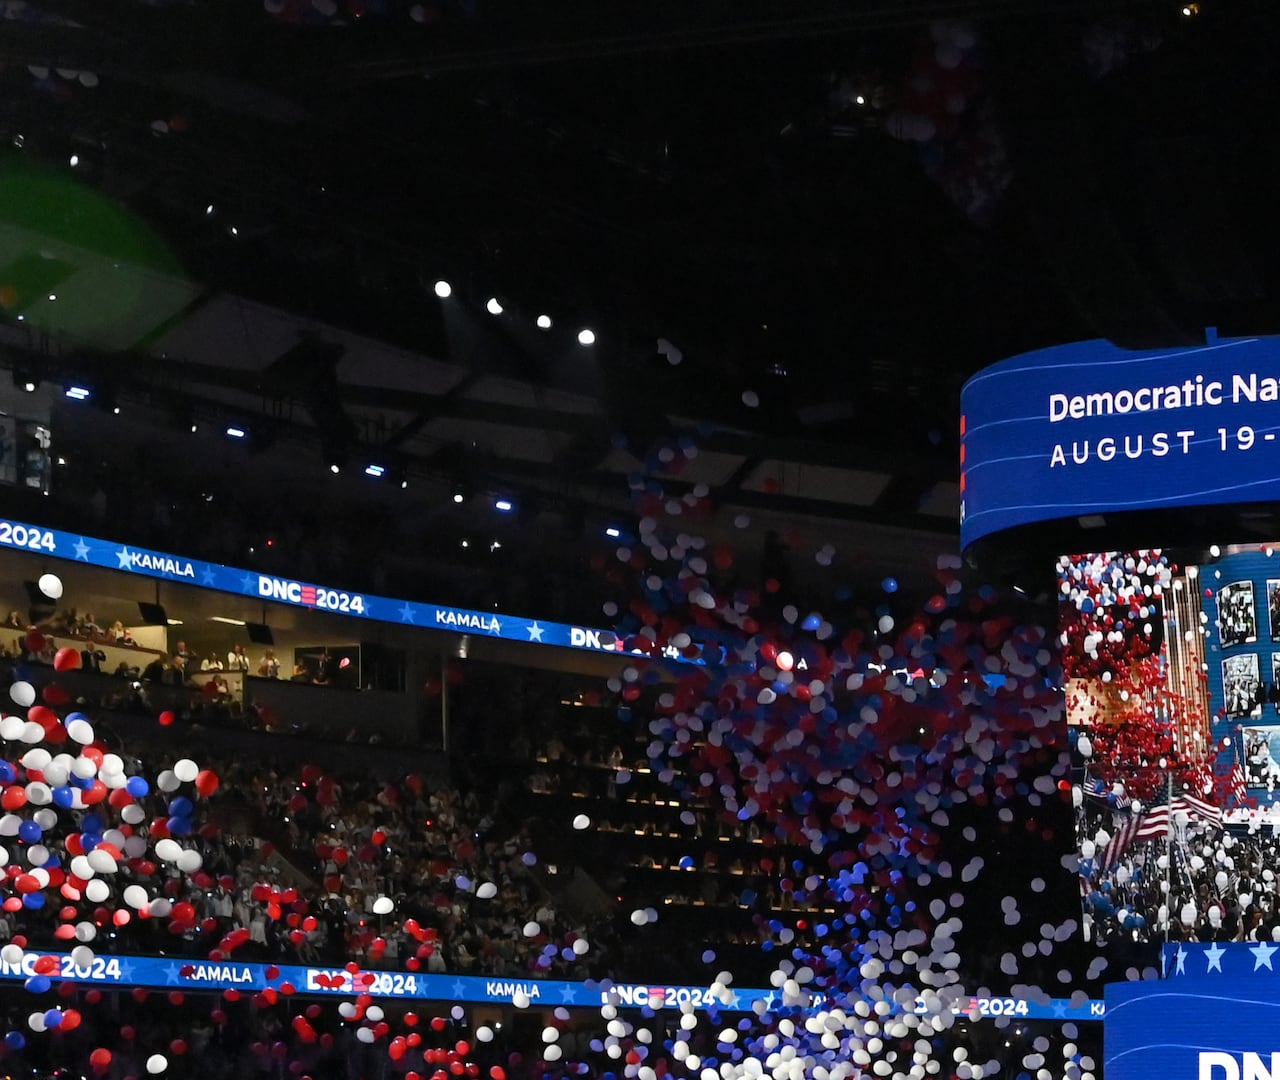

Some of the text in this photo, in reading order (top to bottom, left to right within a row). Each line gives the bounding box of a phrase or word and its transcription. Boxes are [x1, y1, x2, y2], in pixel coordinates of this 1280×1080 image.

[1049, 374, 1222, 422] Democratic
[1050, 429, 1195, 467] AUGUST
[0, 522, 500, 631] 2024 KAMALA DNC 2024 KAMALA
[185, 966, 252, 984] KAMALA
[486, 982, 540, 1000] KAMALA
[665, 988, 715, 1008] 2024
[978, 998, 1029, 1017] 2024
